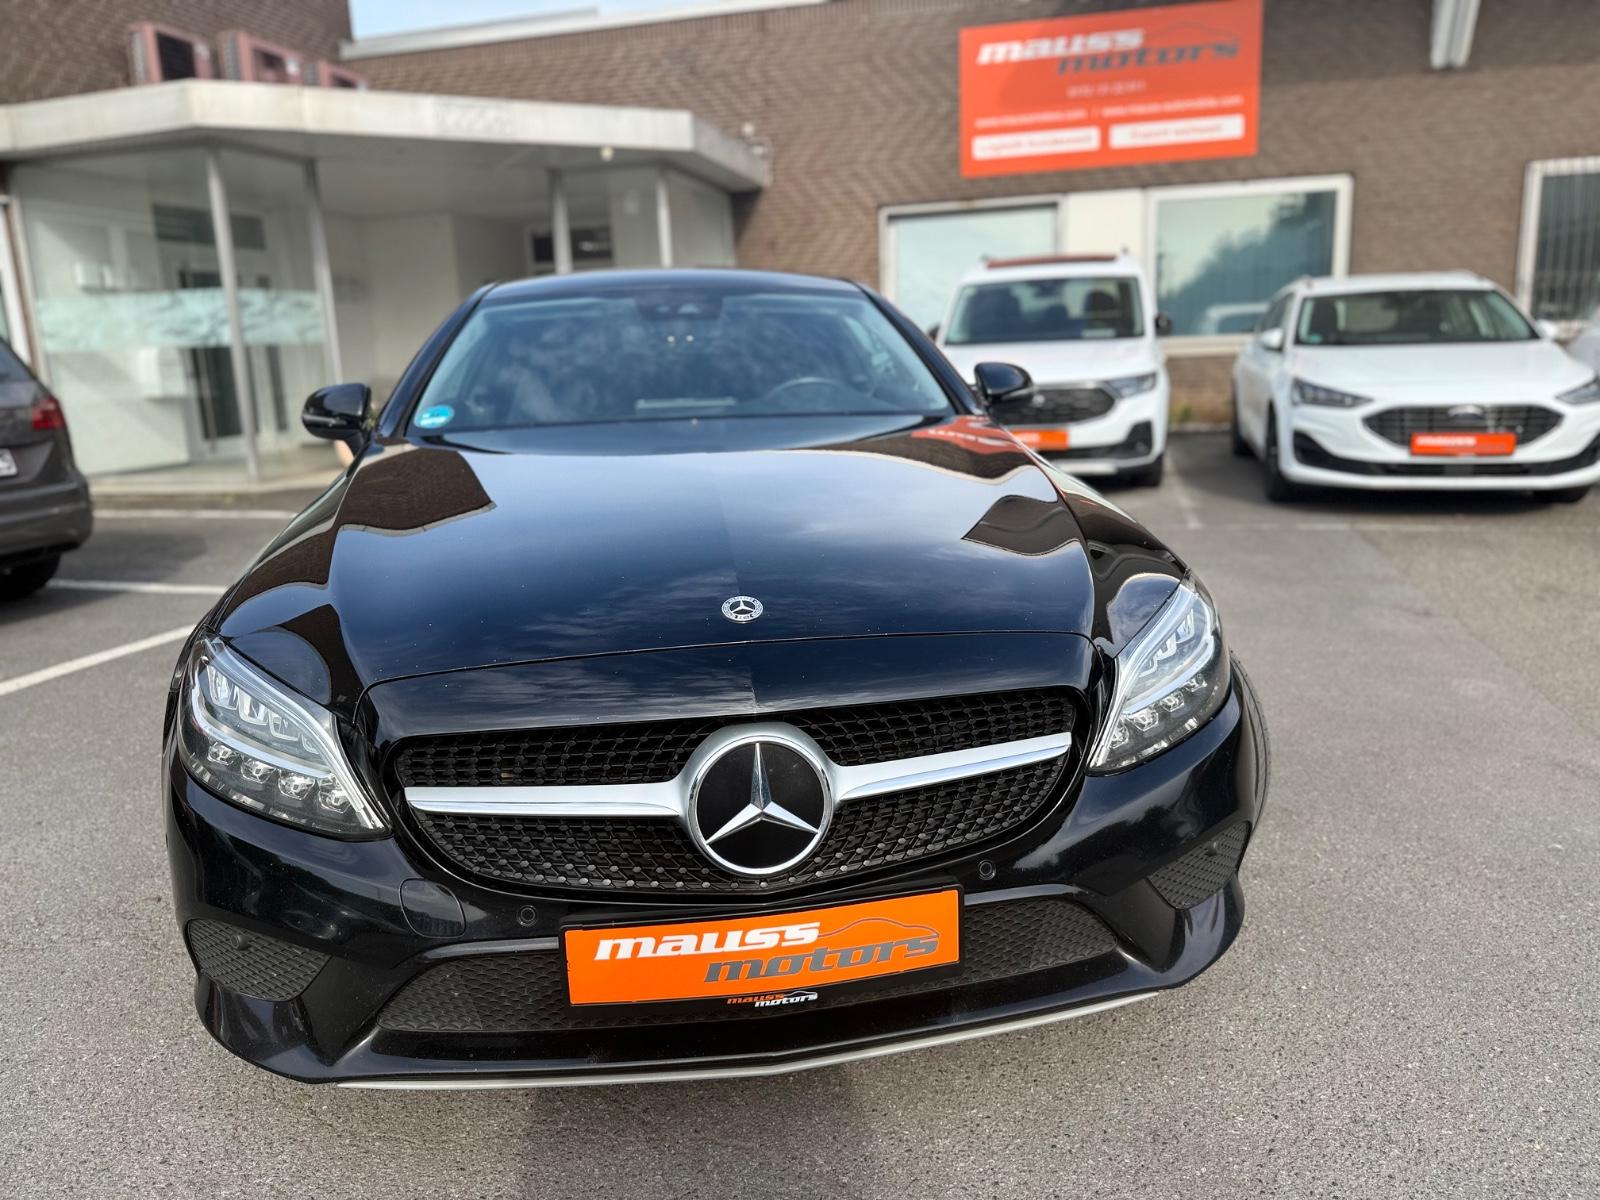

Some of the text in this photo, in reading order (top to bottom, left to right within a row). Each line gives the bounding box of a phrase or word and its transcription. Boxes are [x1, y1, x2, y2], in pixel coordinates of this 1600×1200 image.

[976, 28, 1144, 65] mauss
[1057, 41, 1240, 75] motors
[594, 921, 821, 961] mauss
[703, 935, 940, 983] motors
[726, 993, 785, 1005] mauss
[754, 993, 818, 1008] motors
